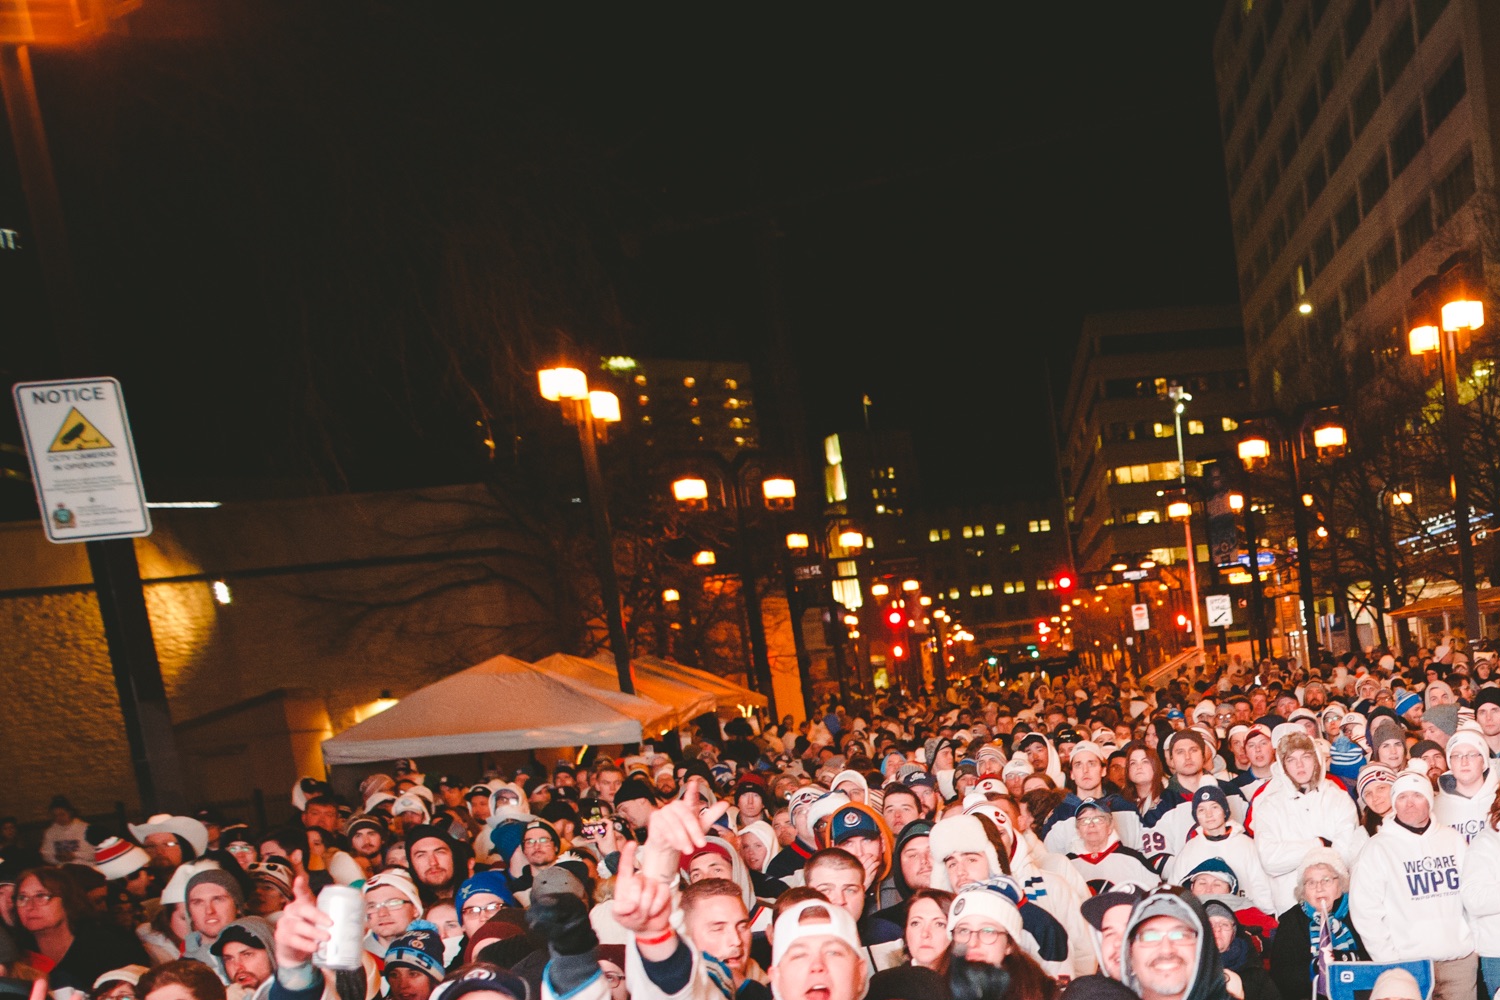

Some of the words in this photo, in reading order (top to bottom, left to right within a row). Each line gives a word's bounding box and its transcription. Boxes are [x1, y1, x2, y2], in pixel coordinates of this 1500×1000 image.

[32, 387, 105, 405] NOTICE
[48, 452, 72, 462] CCTV
[74, 451, 118, 461] CAMERAS
[64, 461, 116, 471] OPERATION
[1141, 832, 1165, 854] 29
[1406, 868, 1460, 896] WPG
